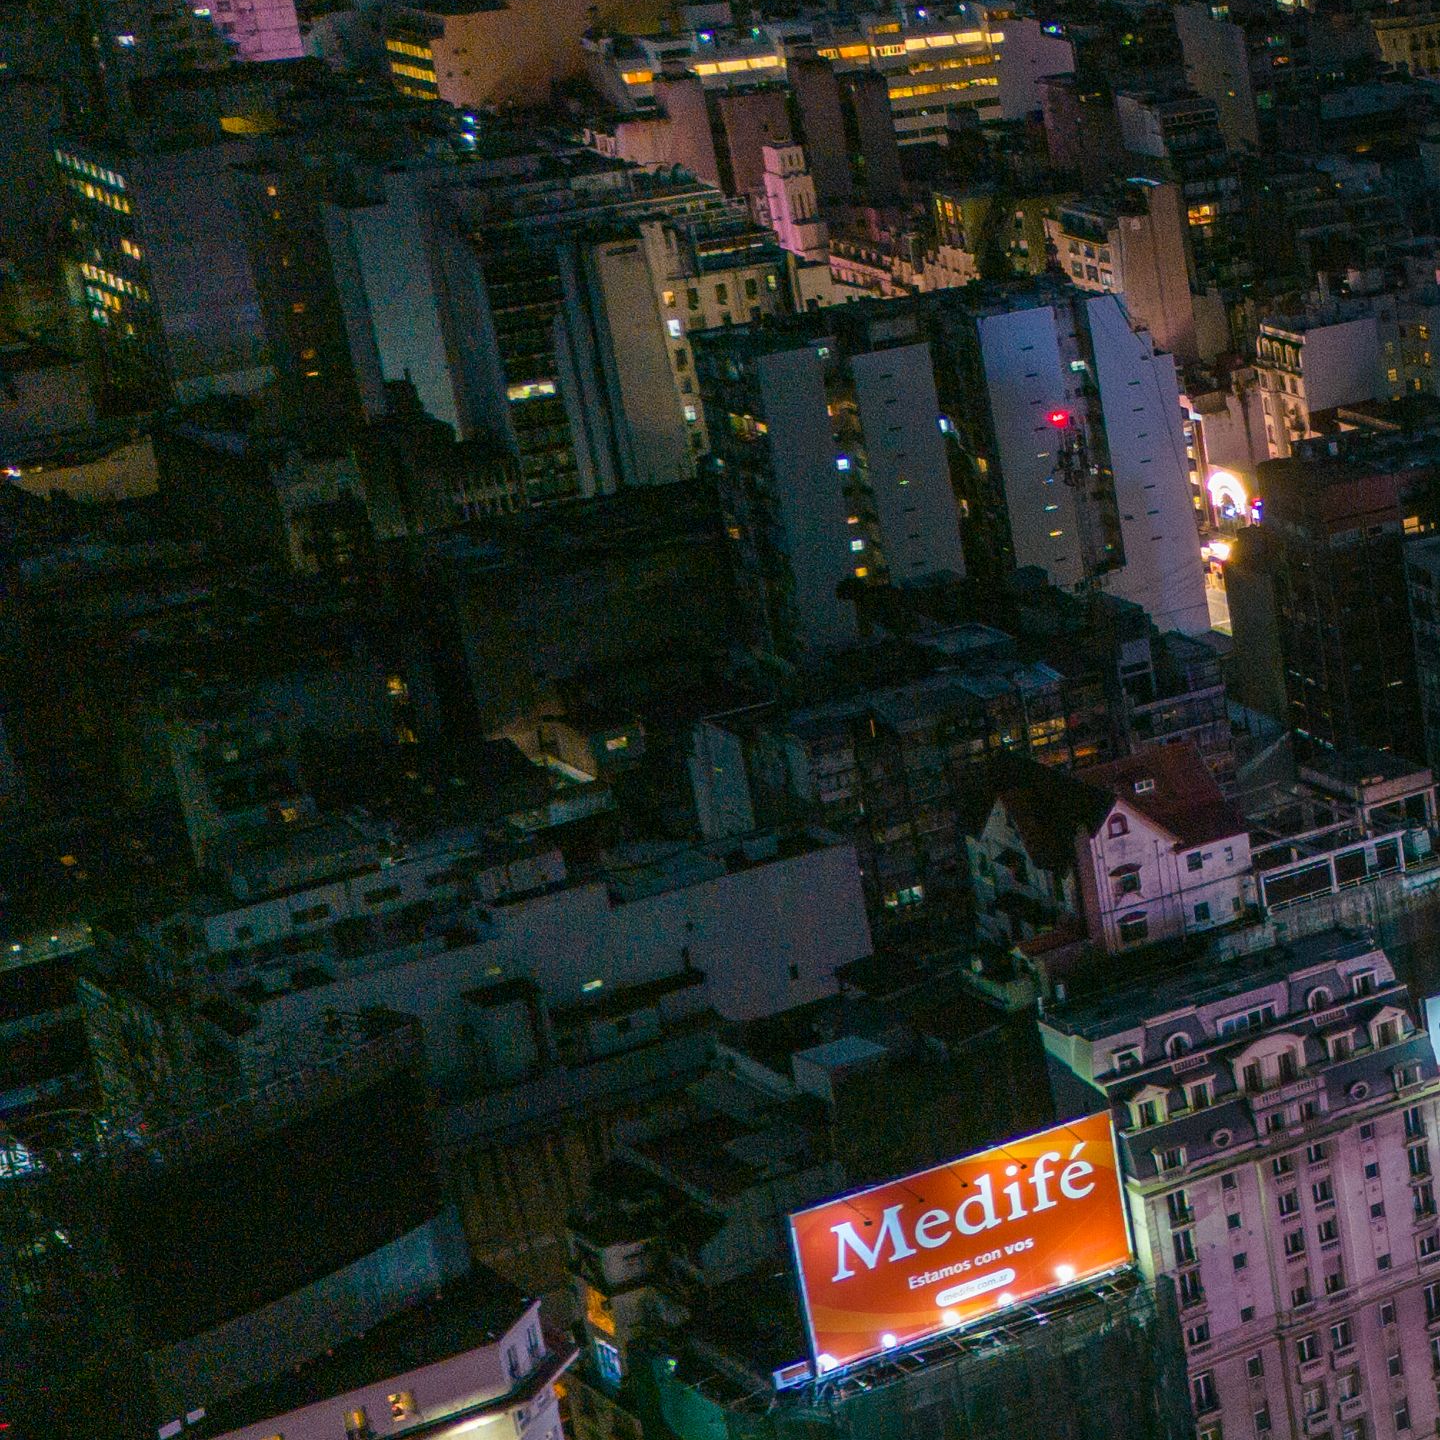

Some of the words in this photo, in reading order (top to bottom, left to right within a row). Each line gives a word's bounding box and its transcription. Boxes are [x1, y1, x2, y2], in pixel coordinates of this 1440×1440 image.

[830, 1144, 1095, 1282] Medifé
[909, 1260, 971, 1290] Estamos
[974, 1250, 1001, 1266] con
[1004, 1238, 1034, 1255] vos
